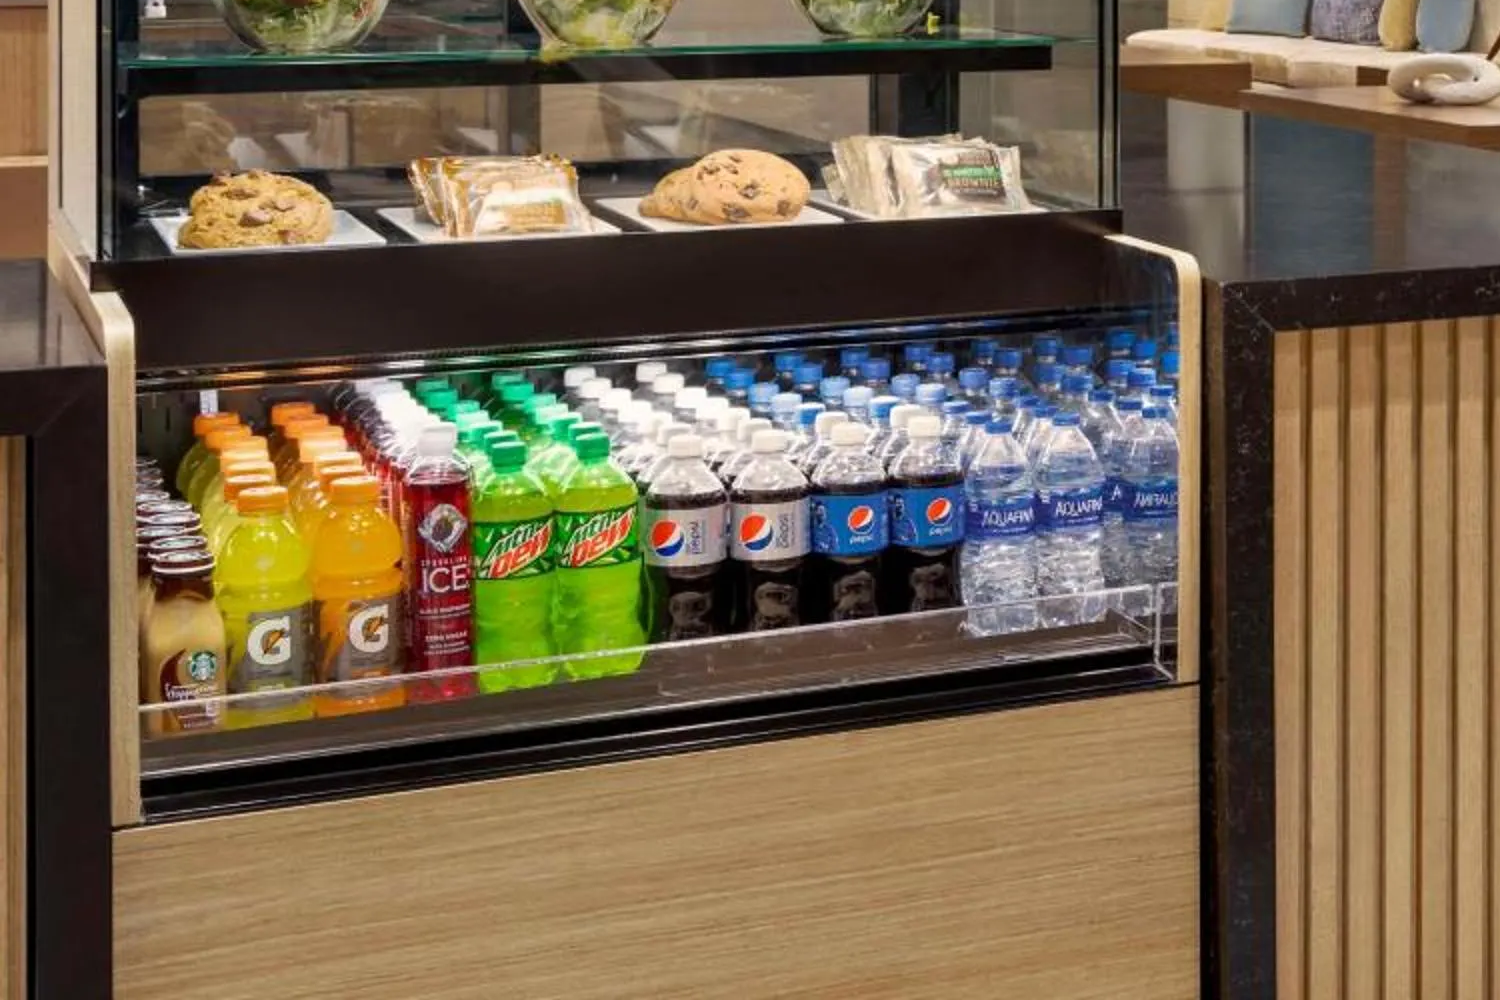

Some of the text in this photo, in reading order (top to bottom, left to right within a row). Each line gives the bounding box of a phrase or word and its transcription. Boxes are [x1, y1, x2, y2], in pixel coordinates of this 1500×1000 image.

[422, 563, 468, 594] ICE
[247, 616, 291, 665] G
[349, 604, 389, 652] G
